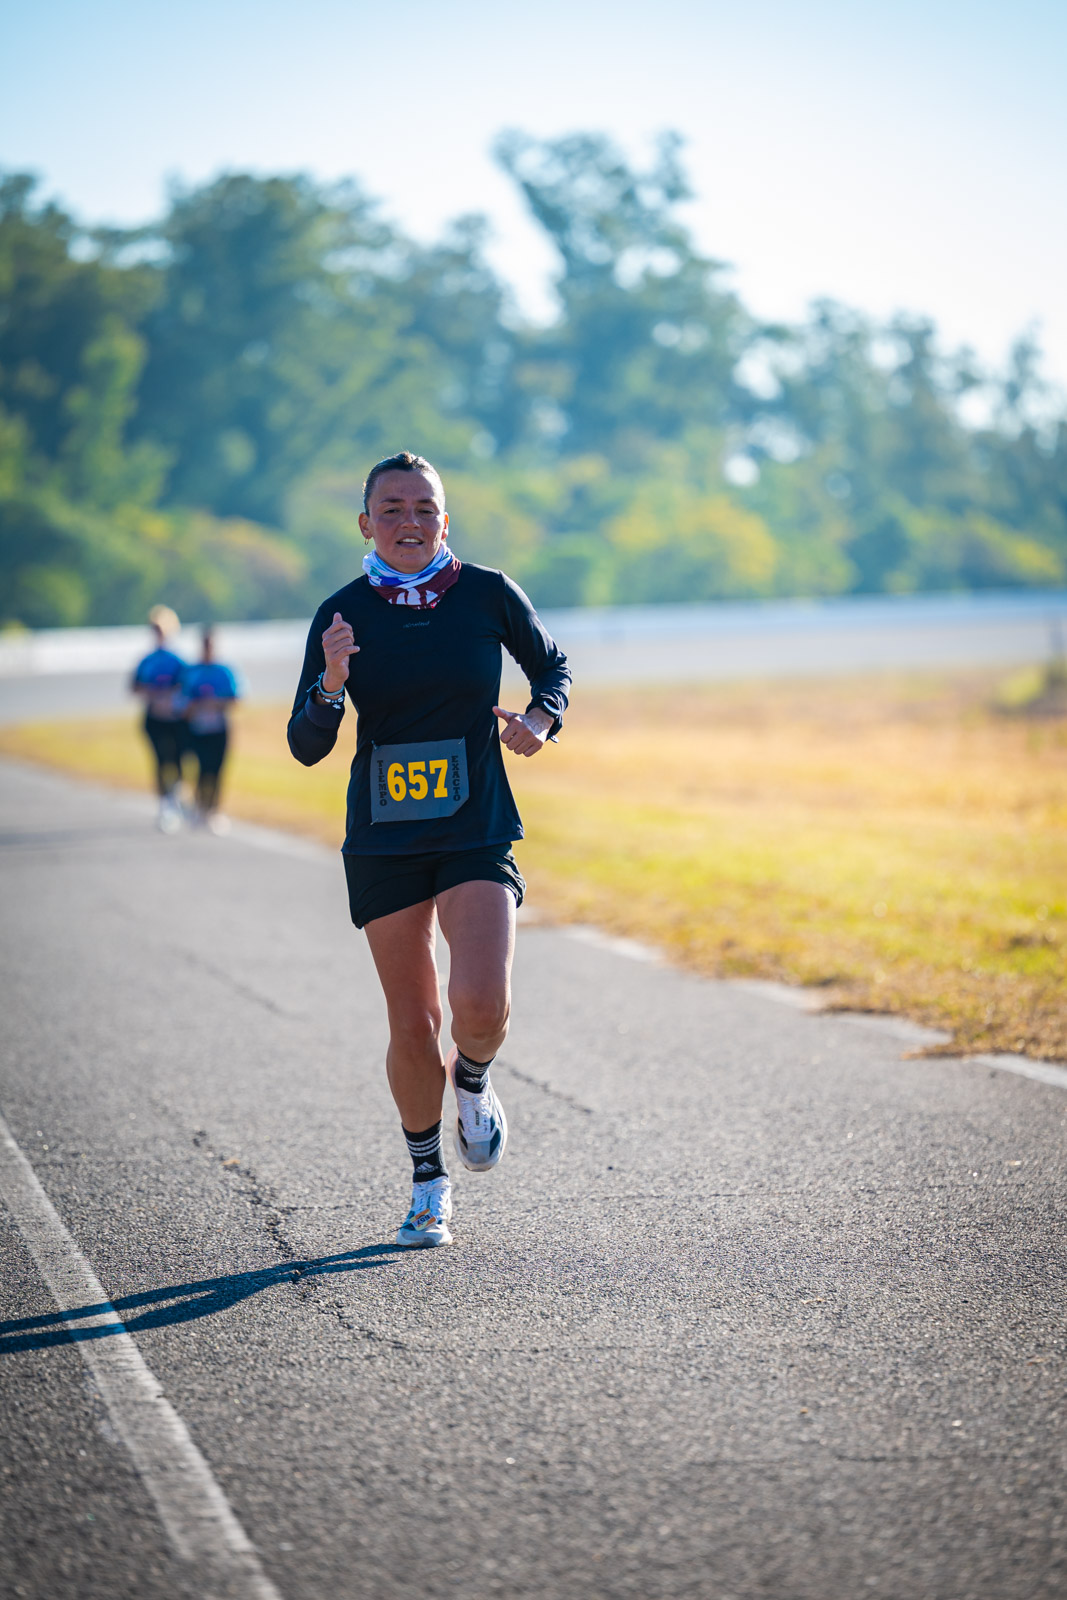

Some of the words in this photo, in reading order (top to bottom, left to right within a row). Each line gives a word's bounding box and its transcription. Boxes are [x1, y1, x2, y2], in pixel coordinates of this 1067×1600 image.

[377, 760, 387, 806] TIEMPO
[387, 759, 448, 801] 657
[451, 755, 461, 801] EXACTO
